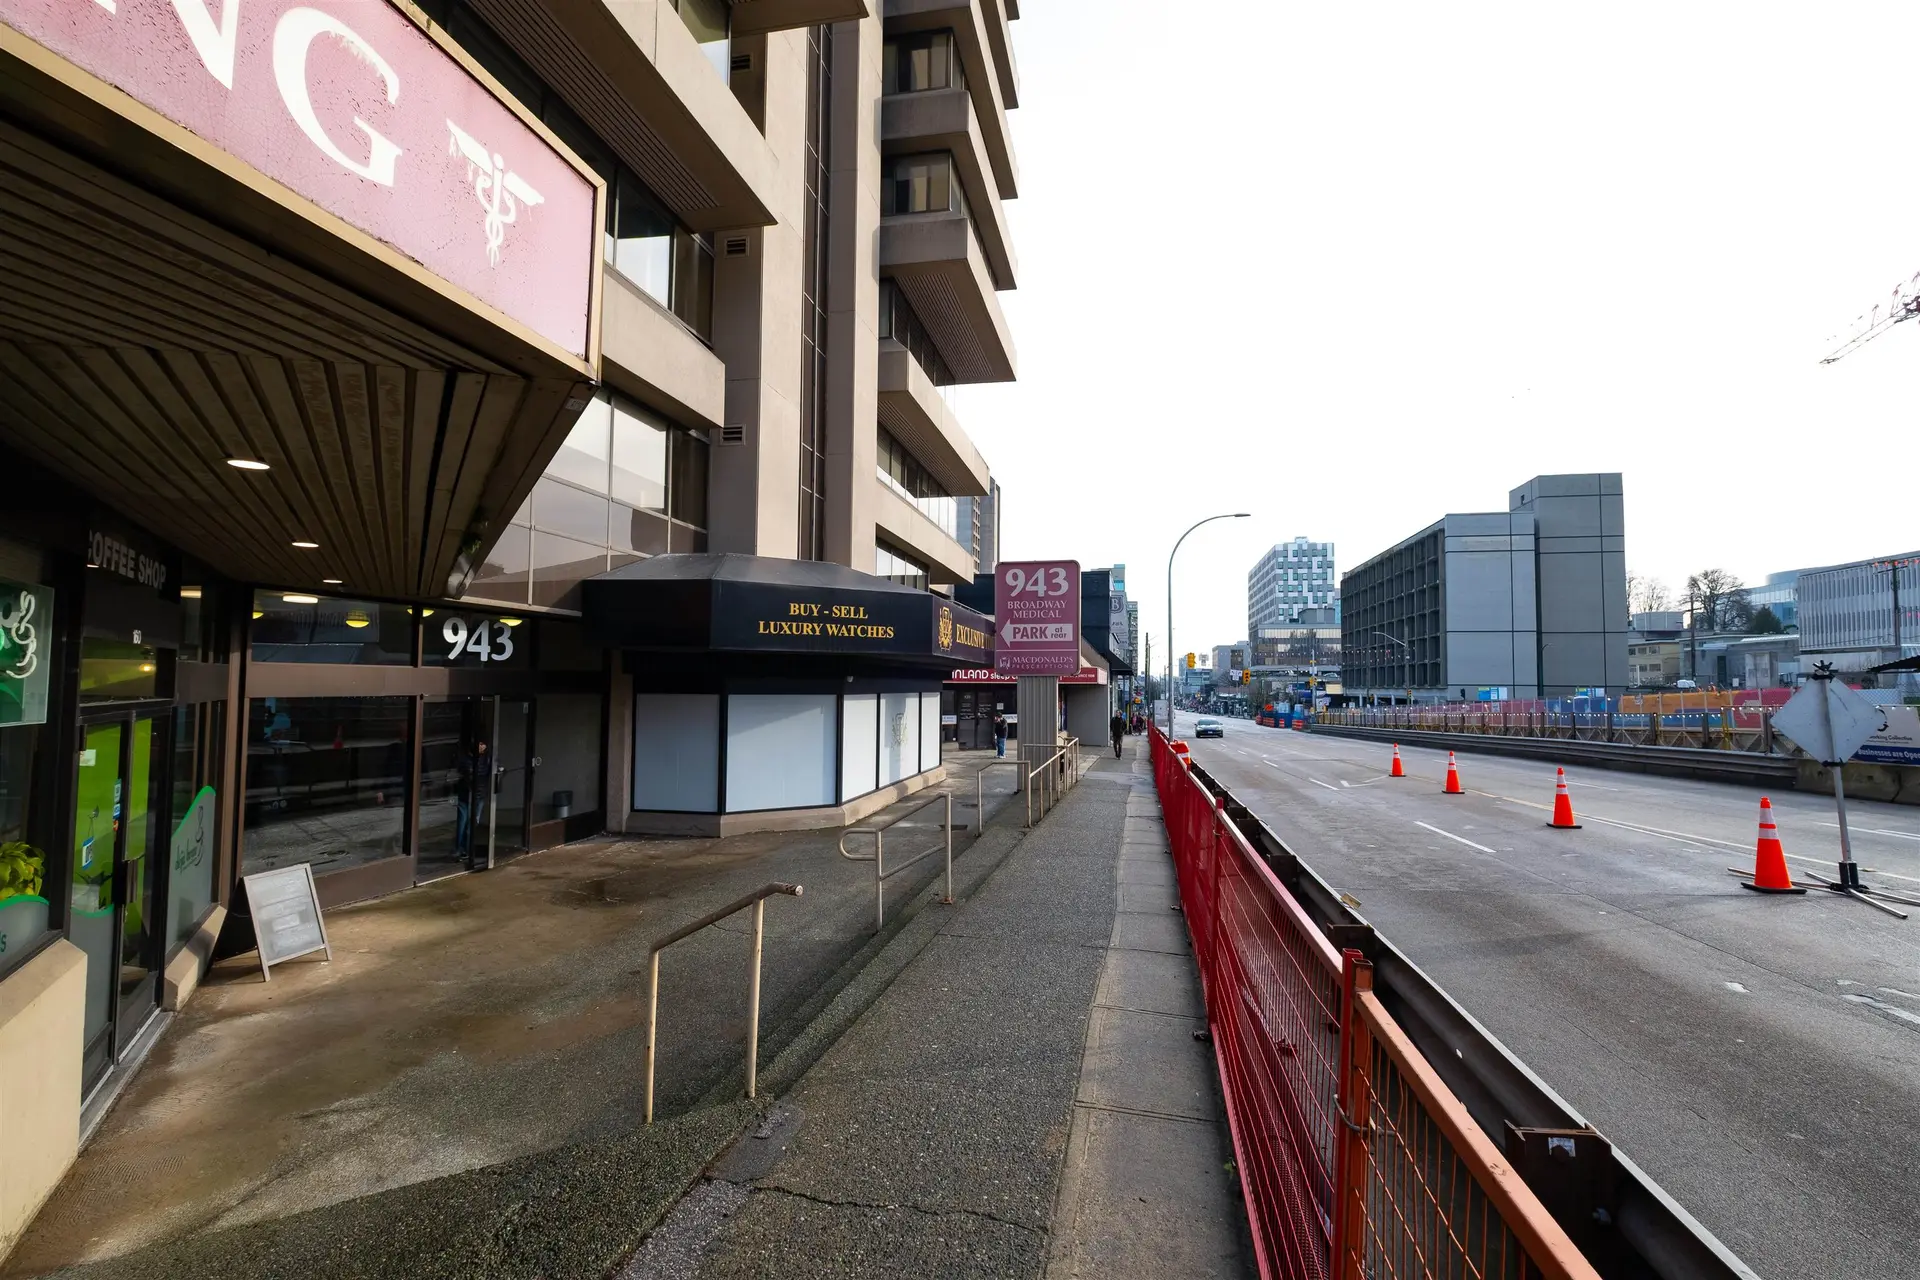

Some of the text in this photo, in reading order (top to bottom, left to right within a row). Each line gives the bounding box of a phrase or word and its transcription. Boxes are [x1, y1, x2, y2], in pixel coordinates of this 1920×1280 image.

[138, 554, 166, 590] SHOP
[1005, 567, 1069, 598] 943
[789, 603, 821, 616] BUY
[832, 605, 868, 619] SELL
[1007, 600, 1068, 610] BROADWAY
[1013, 609, 1062, 619] MEDICAL
[758, 621, 895, 639] LUXURY WATCHES
[1012, 626, 1049, 640] PARK
[1051, 632, 1067, 640] rear
[442, 616, 514, 662] 943
[1013, 656, 1074, 665] MACDONALD'S
